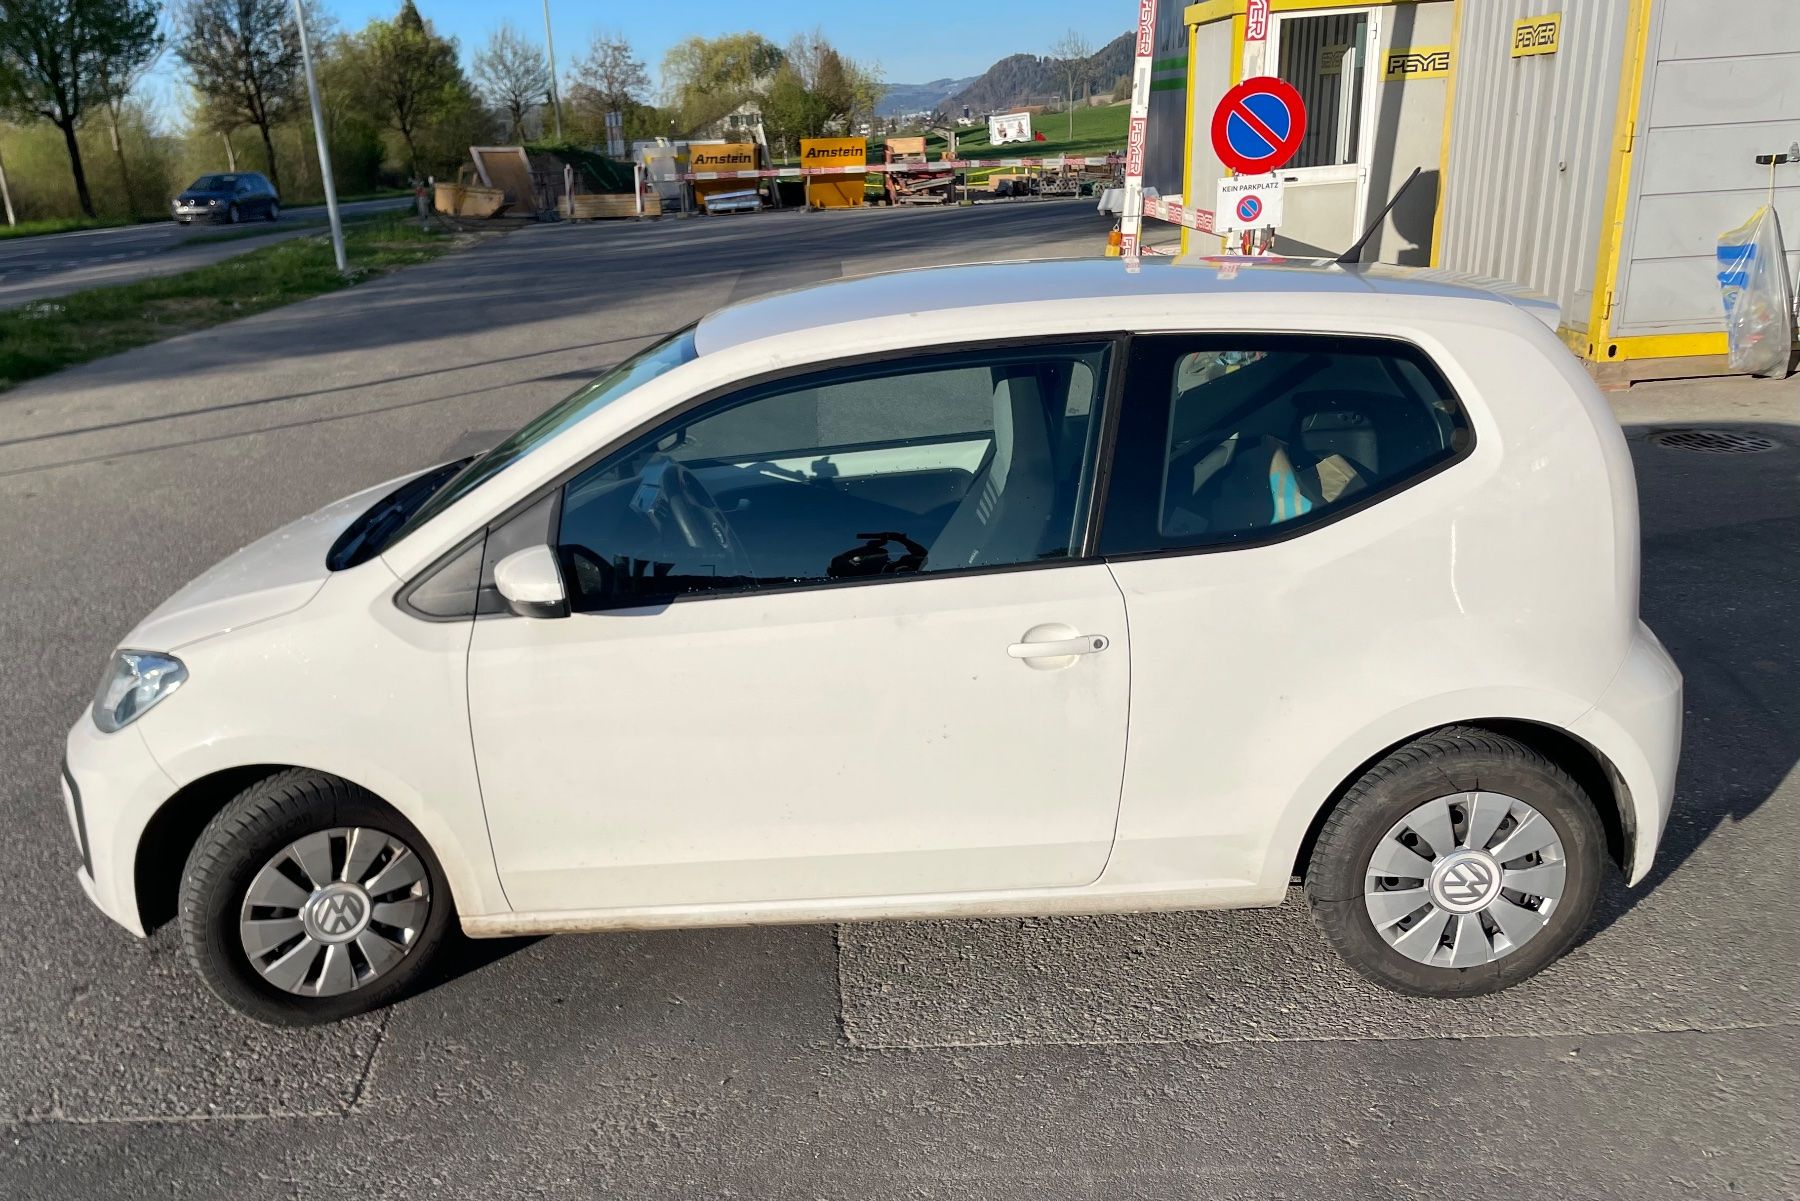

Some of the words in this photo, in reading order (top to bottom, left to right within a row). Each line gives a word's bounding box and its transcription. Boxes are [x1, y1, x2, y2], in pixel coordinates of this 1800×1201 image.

[1514, 22, 1556, 49] PEYER
[1130, 120, 1144, 175] PEYER
[1222, 185, 1238, 193] KEIN
[1239, 182, 1279, 192] PARKPLATZ
